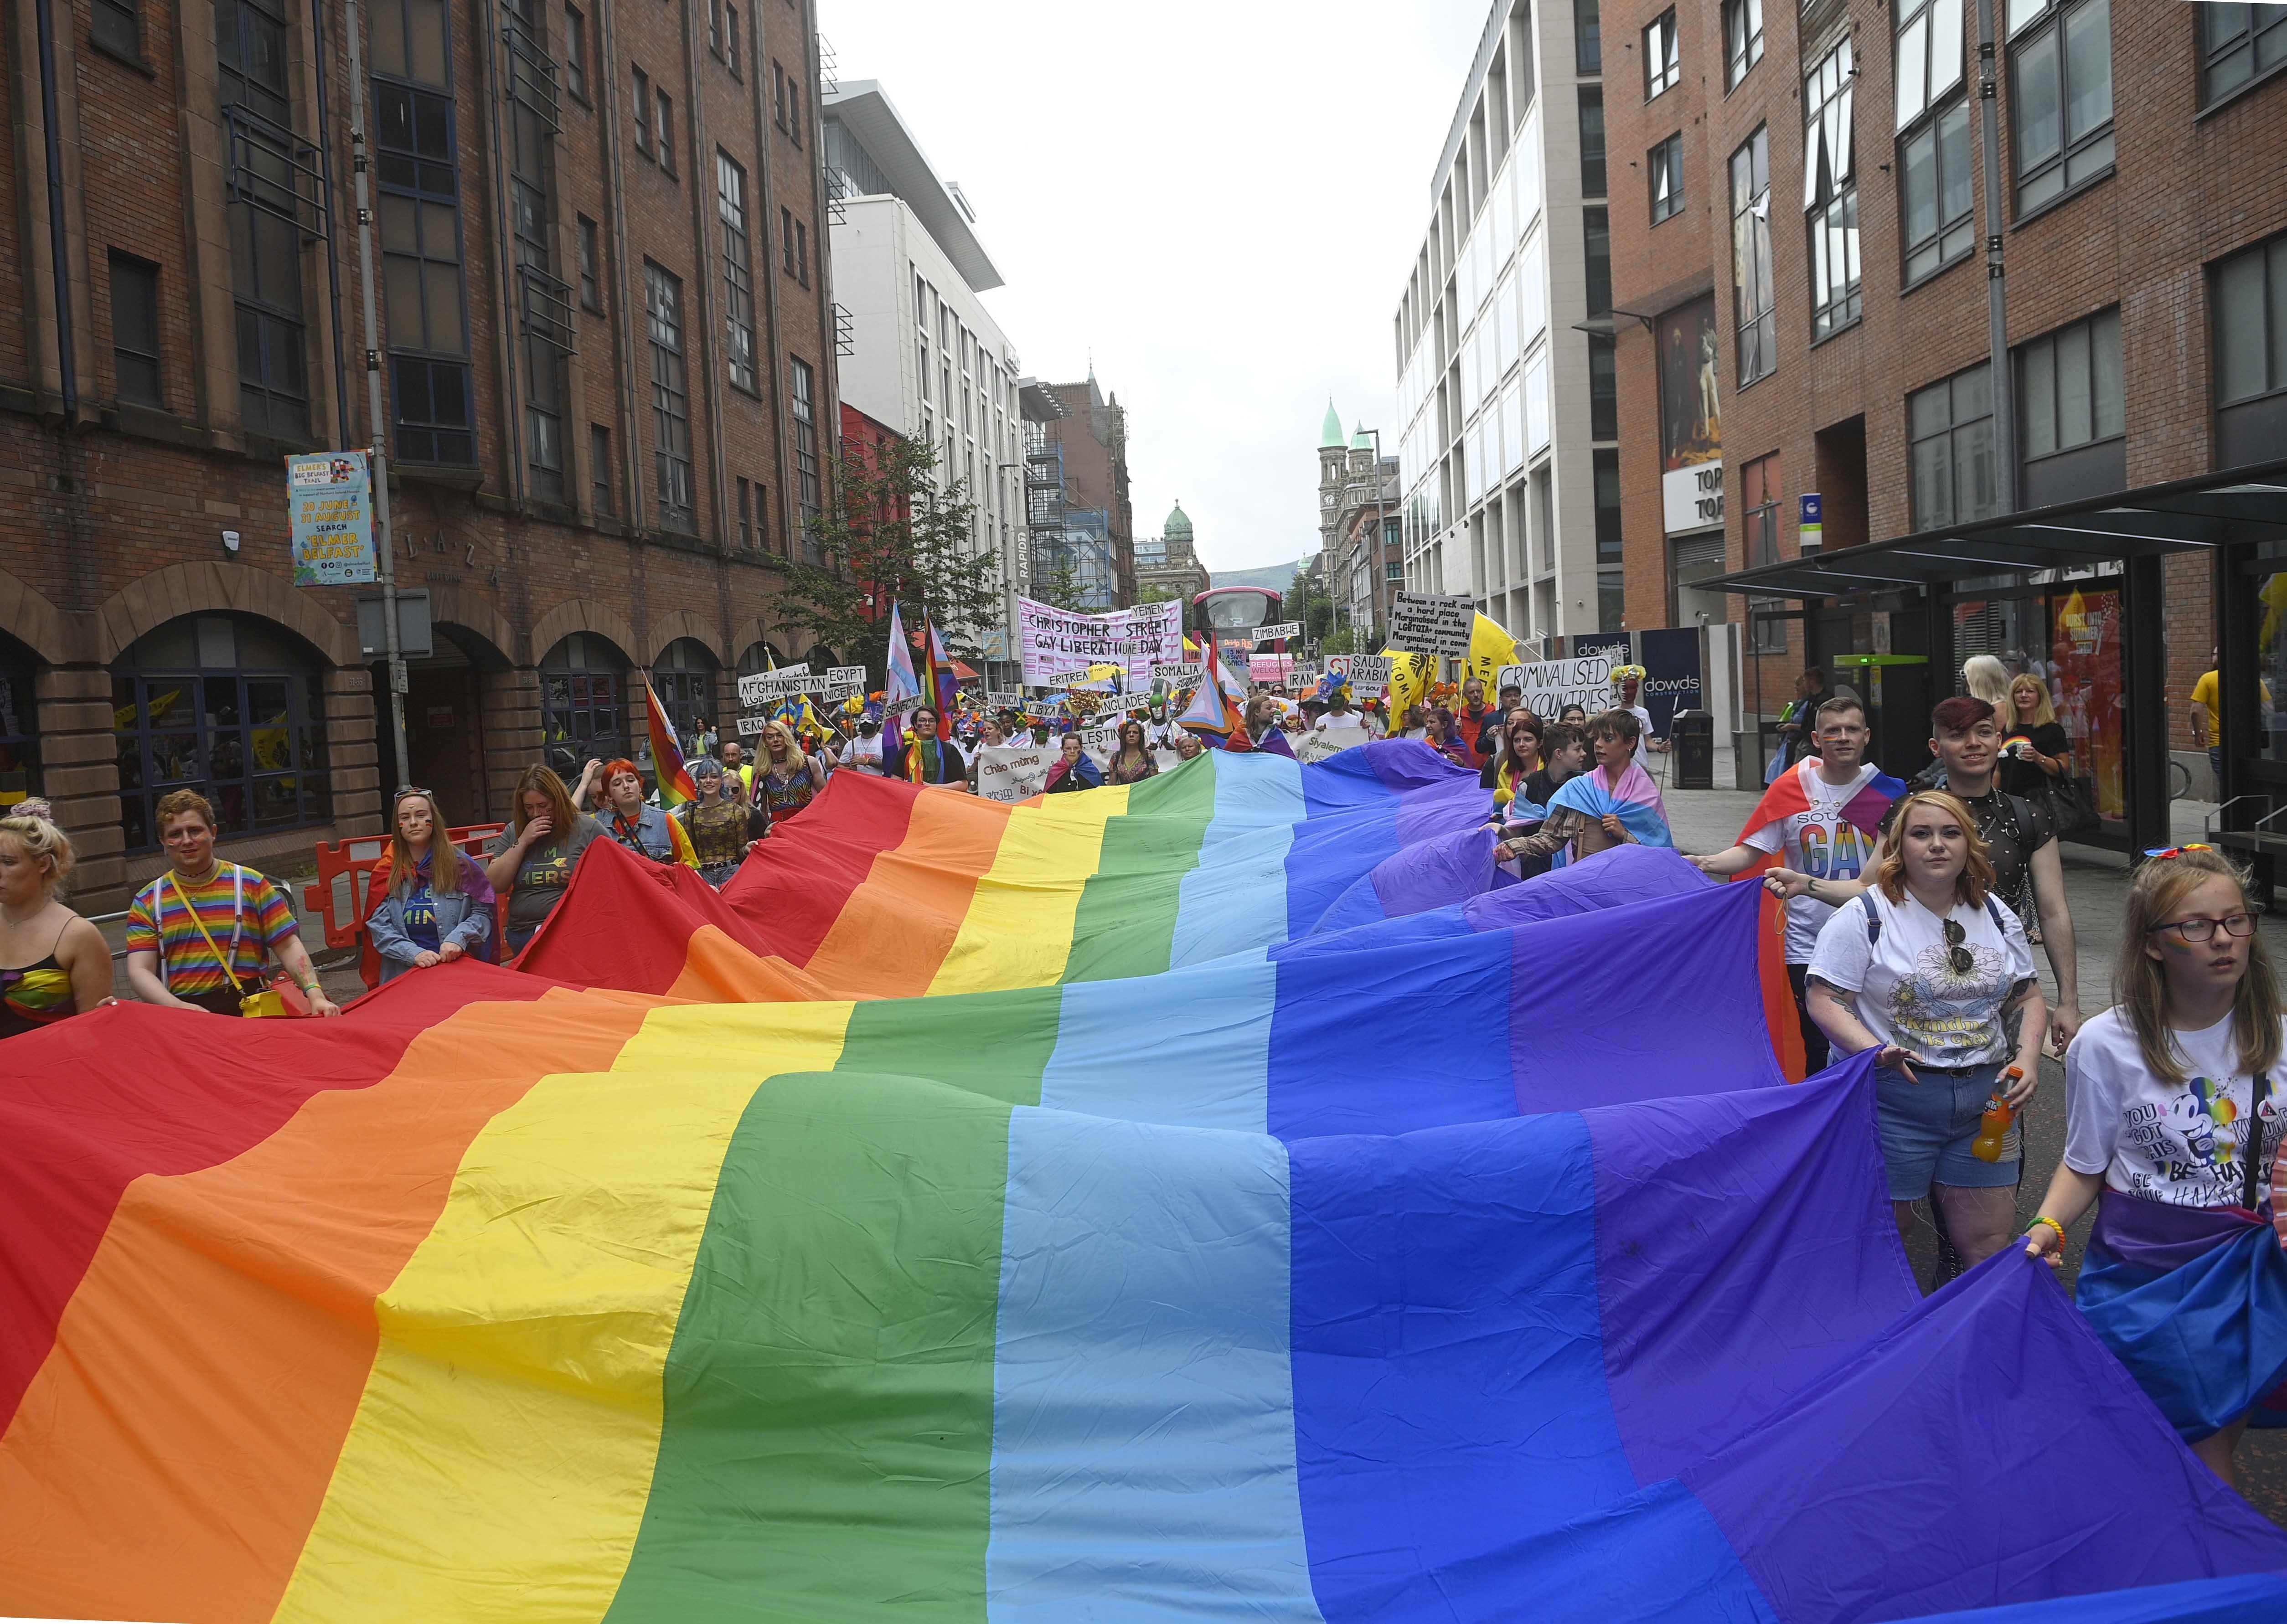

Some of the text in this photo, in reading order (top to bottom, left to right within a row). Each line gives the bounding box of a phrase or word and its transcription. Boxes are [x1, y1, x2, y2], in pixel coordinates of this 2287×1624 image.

[297, 463, 326, 472] ELMER'S
[302, 502, 315, 512] 20
[319, 499, 348, 510] JUNE
[301, 510, 360, 523] 31 AUGUST
[316, 524, 347, 532] SEARCH
[1017, 532, 1028, 578] RAPID7
[1397, 592, 1426, 605] Between
[1439, 599, 1457, 608] rock
[1460, 601, 1475, 610] and
[1132, 604, 1164, 616] YEMEN
[1416, 606, 1435, 615] hard
[1439, 608, 1460, 618] place
[1029, 614, 1169, 637] CHRISTOPHER STREET
[1394, 611, 1467, 628] Marginalised in the
[2066, 613, 2086, 627] BURST
[2087, 611, 2102, 626] INTO
[1254, 624, 1298, 639] ZIMBABWE
[1392, 630, 1436, 644] Marginalised
[1440, 636, 1447, 646] in
[1398, 622, 1470, 640] LGBTQIA+ community
[2070, 626, 2098, 641] SUMMER
[1035, 634, 1163, 655] GAY LIBERATI DAY
[1122, 643, 1138, 655] UAE
[1404, 643, 1460, 657] unities of origin
[1578, 640, 1629, 656] dowds
[1353, 655, 1386, 668] SAUDI
[829, 668, 863, 681] EGYPT
[1049, 670, 1089, 685] ERITREA
[1154, 665, 1199, 677] SOMALIA
[1350, 668, 1389, 682] ARABIA
[1500, 657, 1609, 688] CRIMINALISED
[742, 678, 826, 696] AFGHANISTAN
[1175, 675, 1205, 689] SUDAN
[1290, 673, 1313, 686] IRAN
[1644, 674, 1700, 692] dowds
[824, 684, 862, 701] NIGERIA
[989, 693, 1018, 705] JAMAICA
[885, 696, 921, 717] SENEGAL
[1531, 687, 1608, 718] COUNTRIES
[1027, 704, 1056, 717] LIBYA
[740, 719, 764, 733] IRAQ
[983, 763, 1008, 776] Chào
[1020, 785, 1029, 795] Bi
[1797, 812, 1839, 824] SOU
[2123, 1103, 2157, 1128] YOU
[2131, 1122, 2163, 1145] GOT
[2169, 1160, 2198, 1182] BE
[2132, 1172, 2153, 1188] BE
